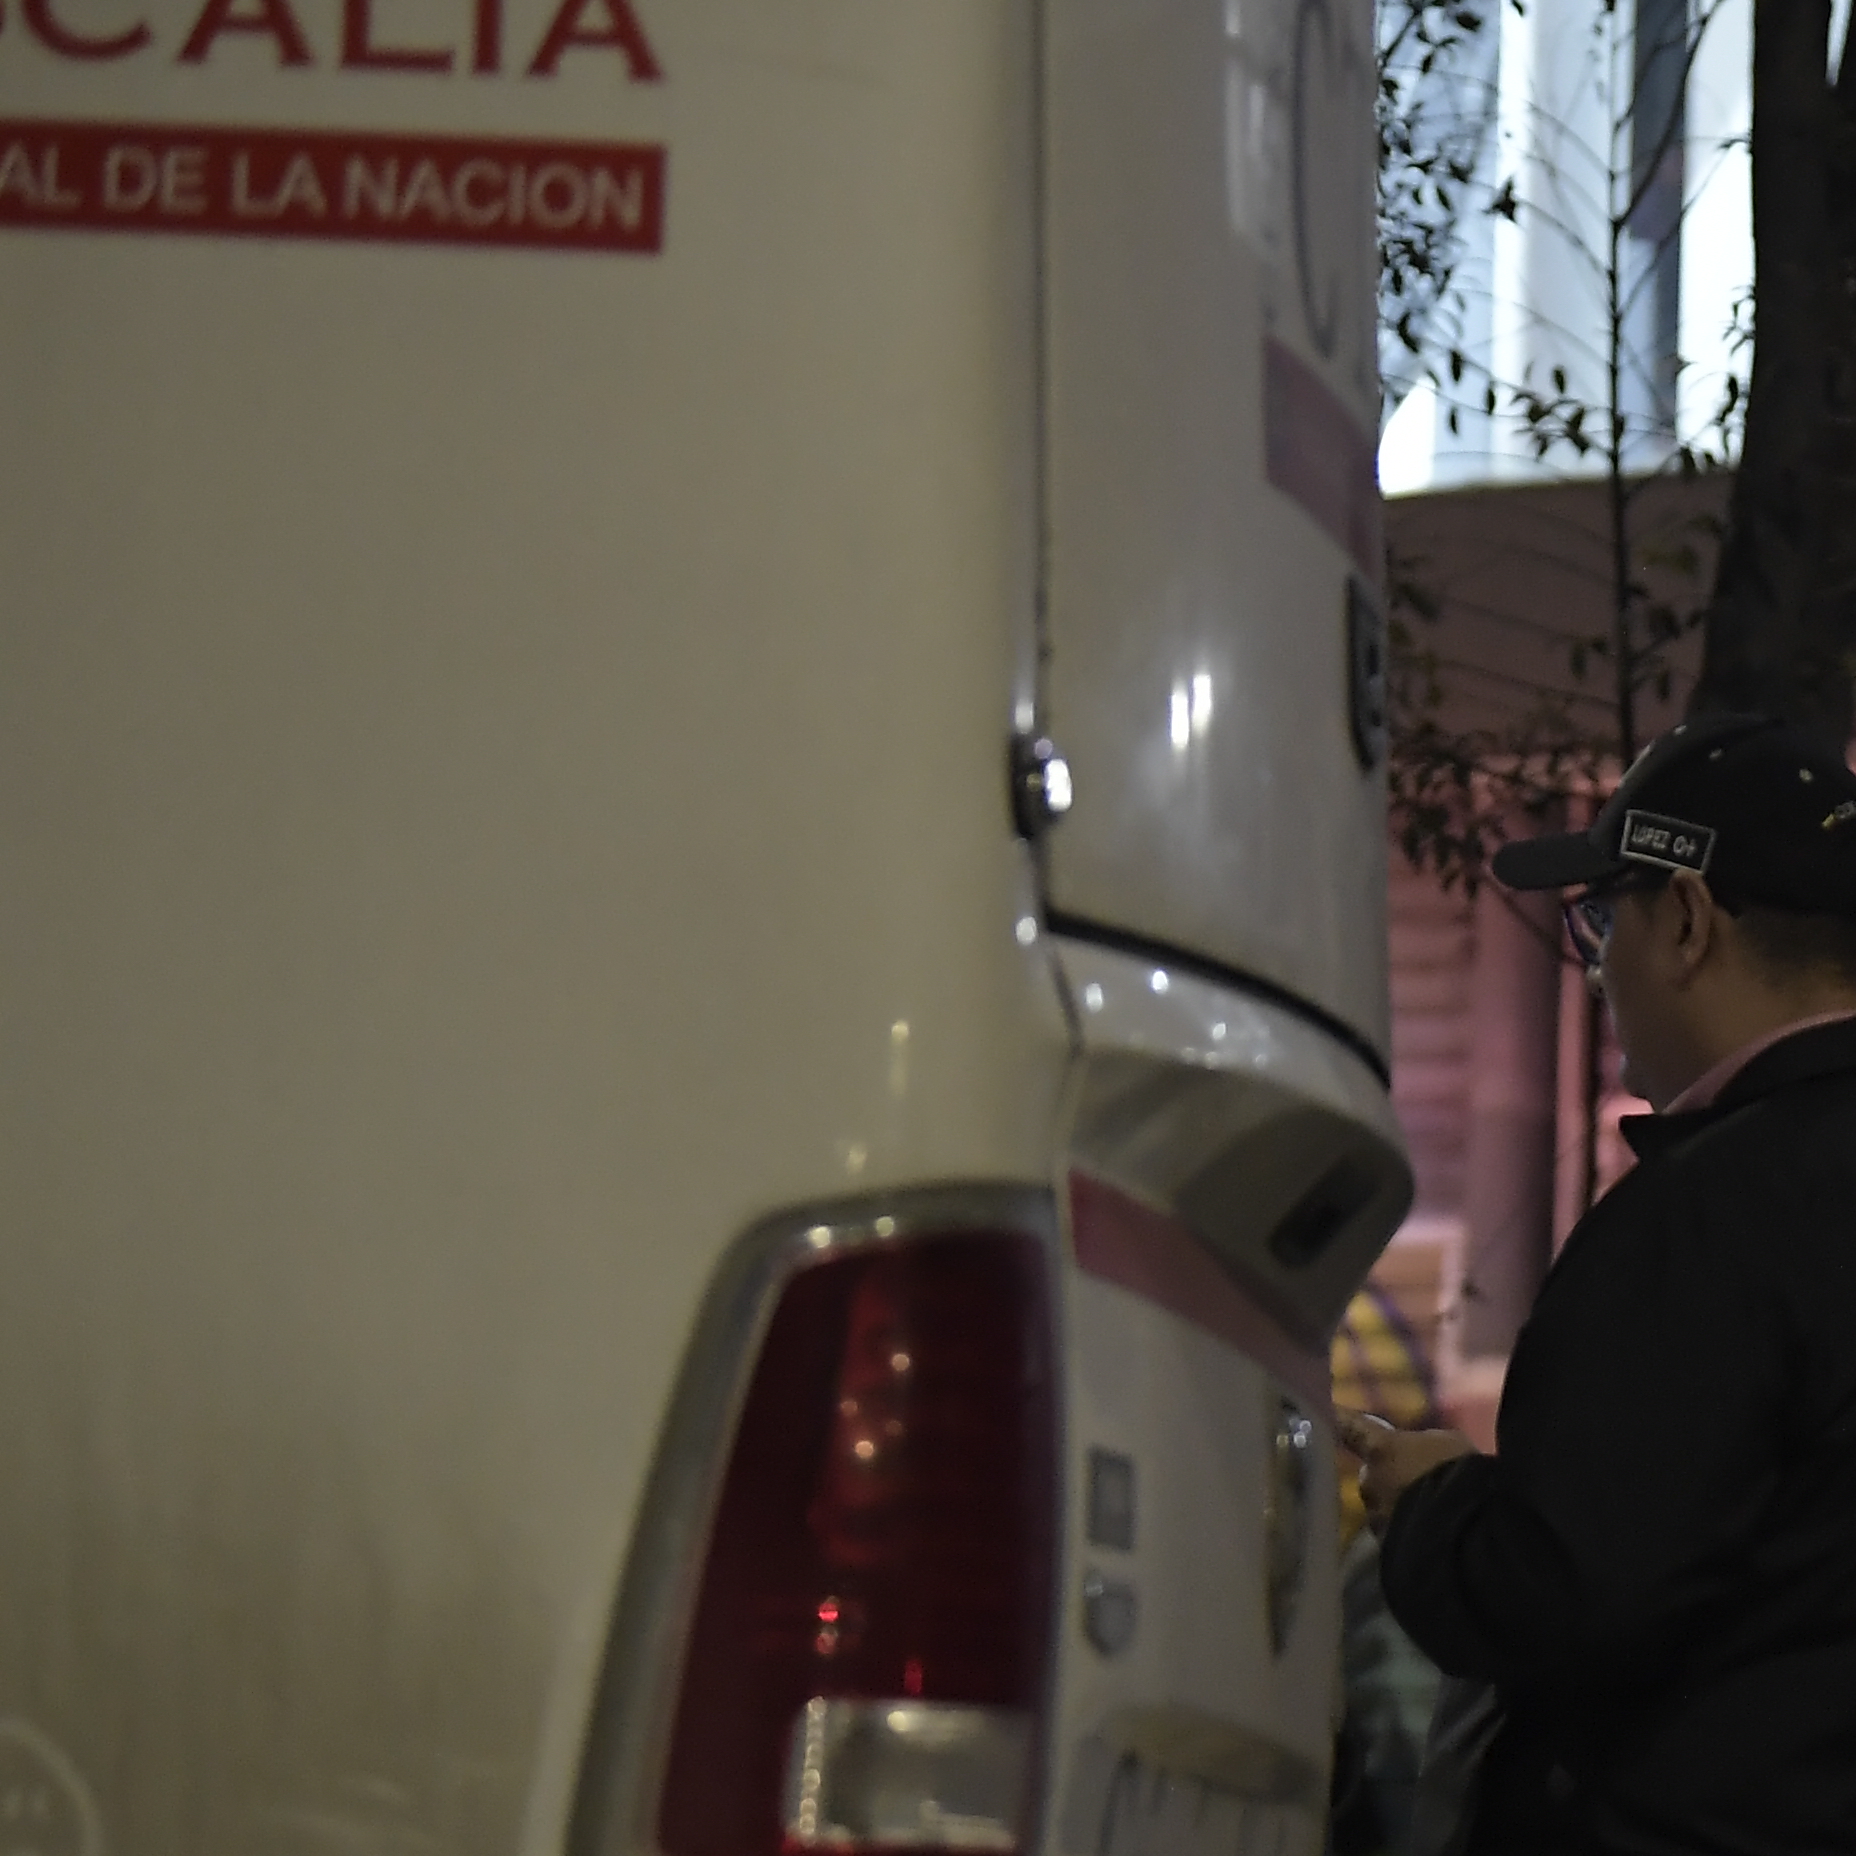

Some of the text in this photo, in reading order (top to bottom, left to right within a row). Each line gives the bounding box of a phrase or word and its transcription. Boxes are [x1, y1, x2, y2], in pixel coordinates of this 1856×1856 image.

[0, 0, 664, 82] CALIA
[103, 144, 208, 214] DE
[231, 150, 328, 219] LA
[342, 153, 646, 232] NACION
